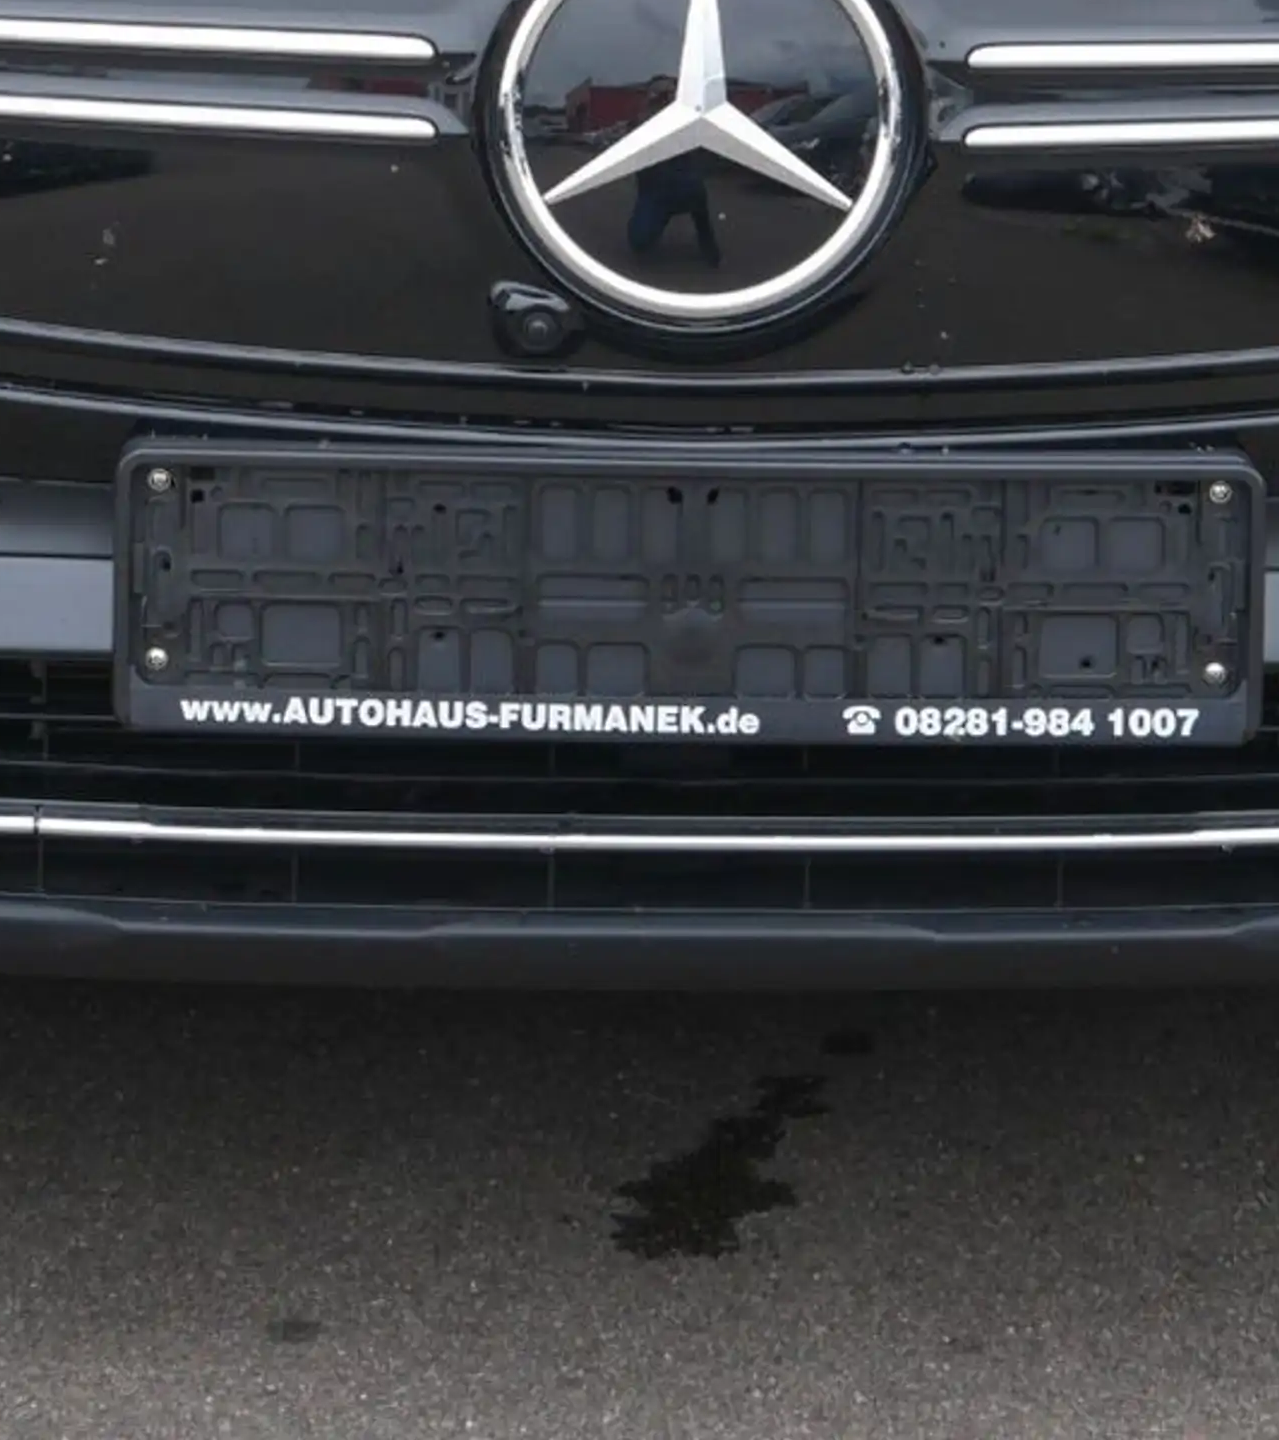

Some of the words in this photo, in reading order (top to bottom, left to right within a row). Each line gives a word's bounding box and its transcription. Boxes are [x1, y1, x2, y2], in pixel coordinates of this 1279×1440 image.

[179, 696, 761, 734] www.AUTOHAUS-FURMANEK.de
[894, 706, 1095, 737] 08281-984
[1107, 707, 1200, 738] 1007
